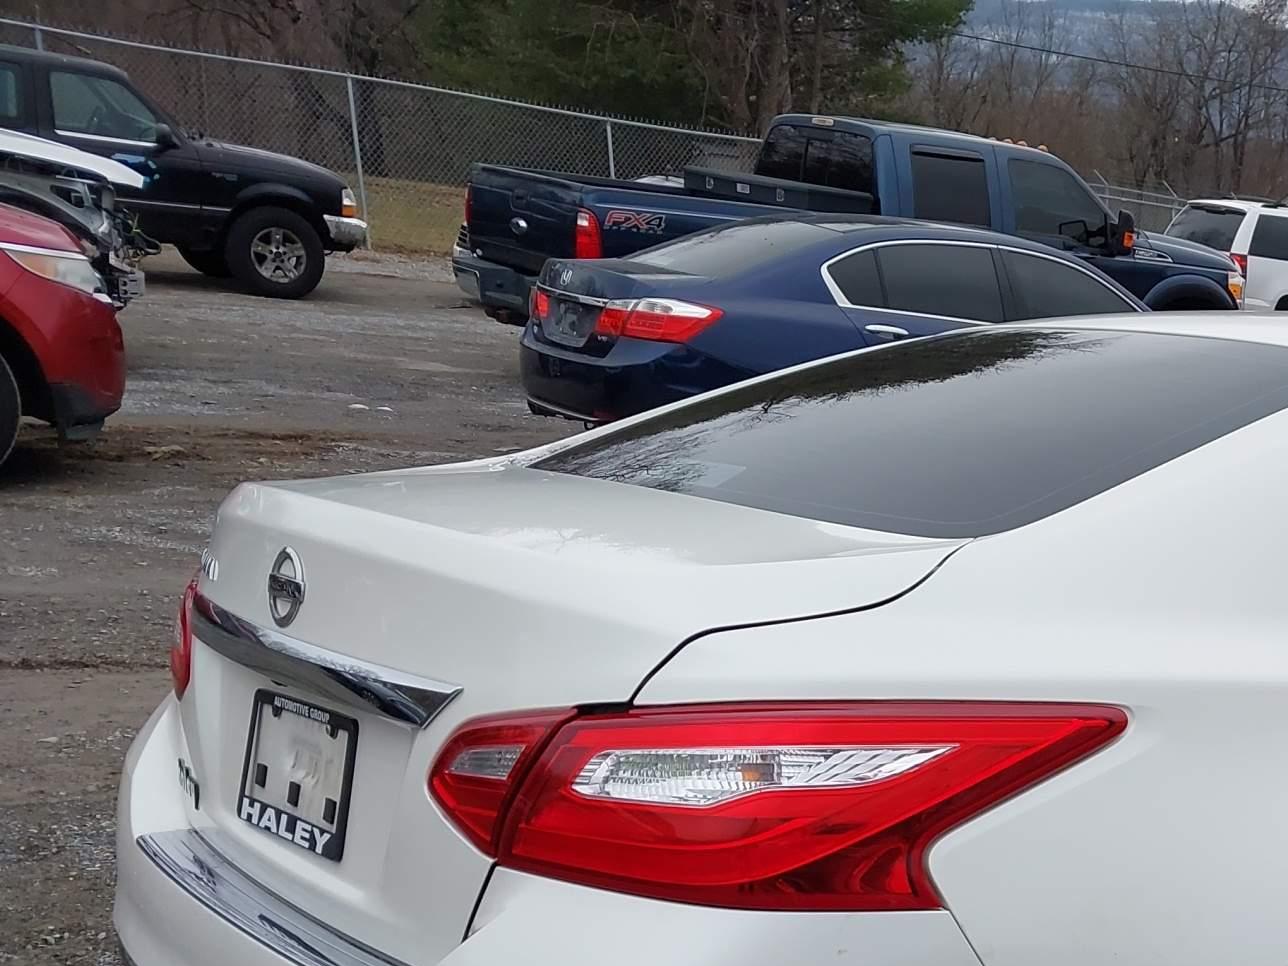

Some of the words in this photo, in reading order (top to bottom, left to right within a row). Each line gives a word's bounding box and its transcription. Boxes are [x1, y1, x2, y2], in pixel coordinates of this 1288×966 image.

[604, 210, 665, 230] FX4
[274, 695, 310, 717] AUTOMOTIVE
[309, 708, 331, 724] GROUP
[240, 796, 332, 855] HALEY
